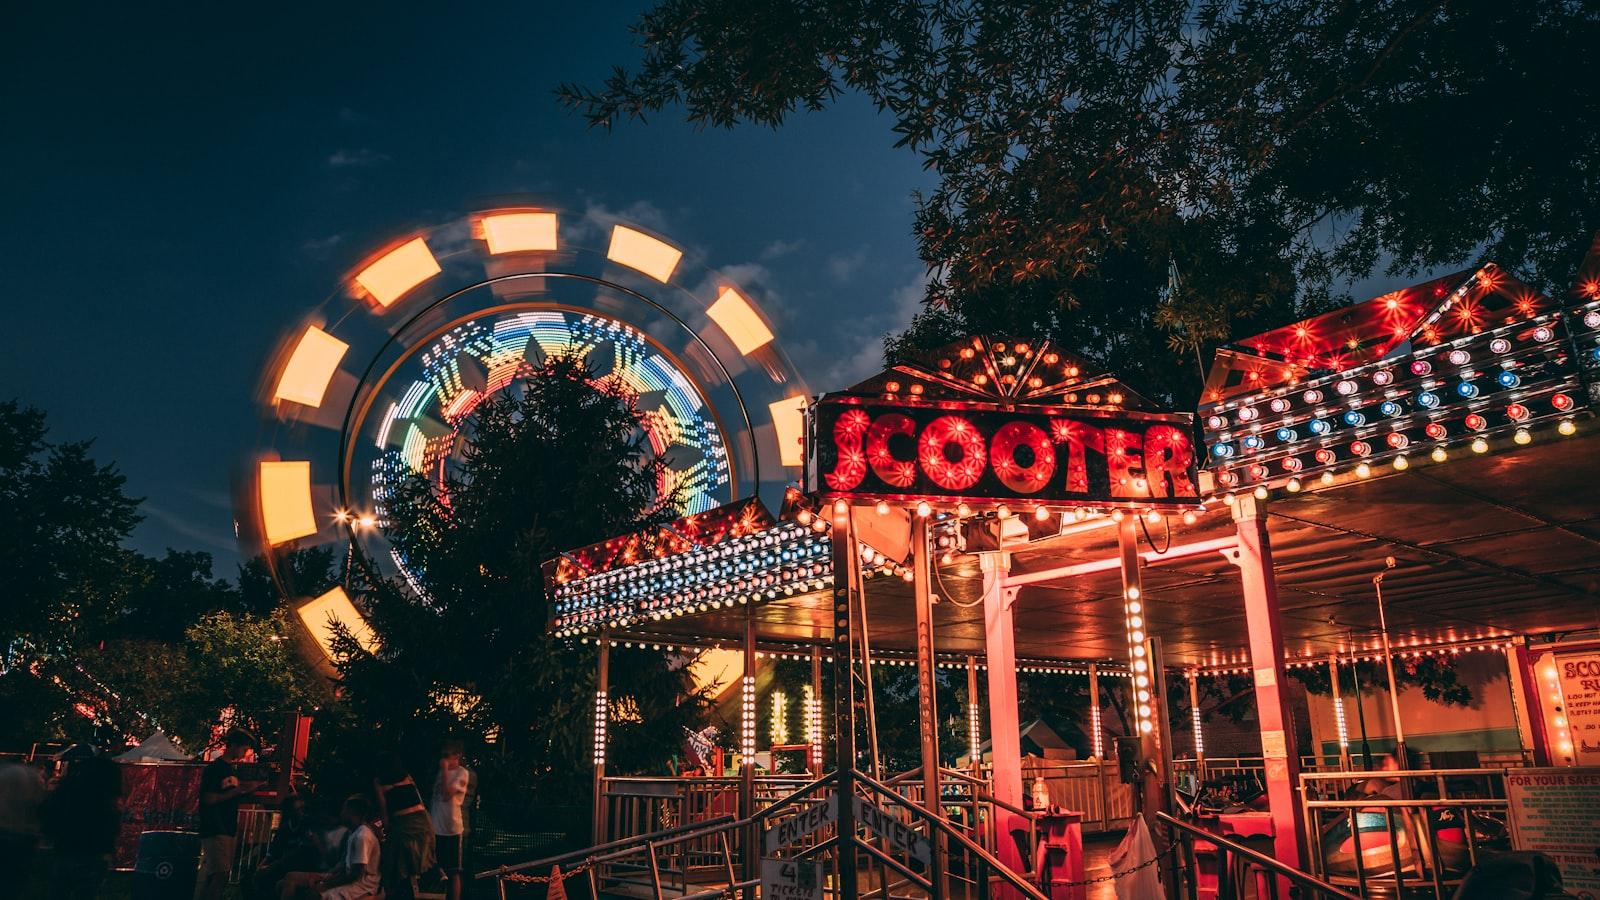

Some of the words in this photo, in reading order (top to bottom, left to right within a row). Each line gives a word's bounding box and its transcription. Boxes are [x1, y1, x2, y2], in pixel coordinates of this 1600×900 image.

[824, 408, 1195, 498] SCOOTER
[1510, 776, 1532, 786] FOR
[1534, 775, 1566, 786] YOUR
[778, 802, 829, 844] ENTER
[861, 802, 917, 854] ENTER
[780, 864, 797, 883] 4
